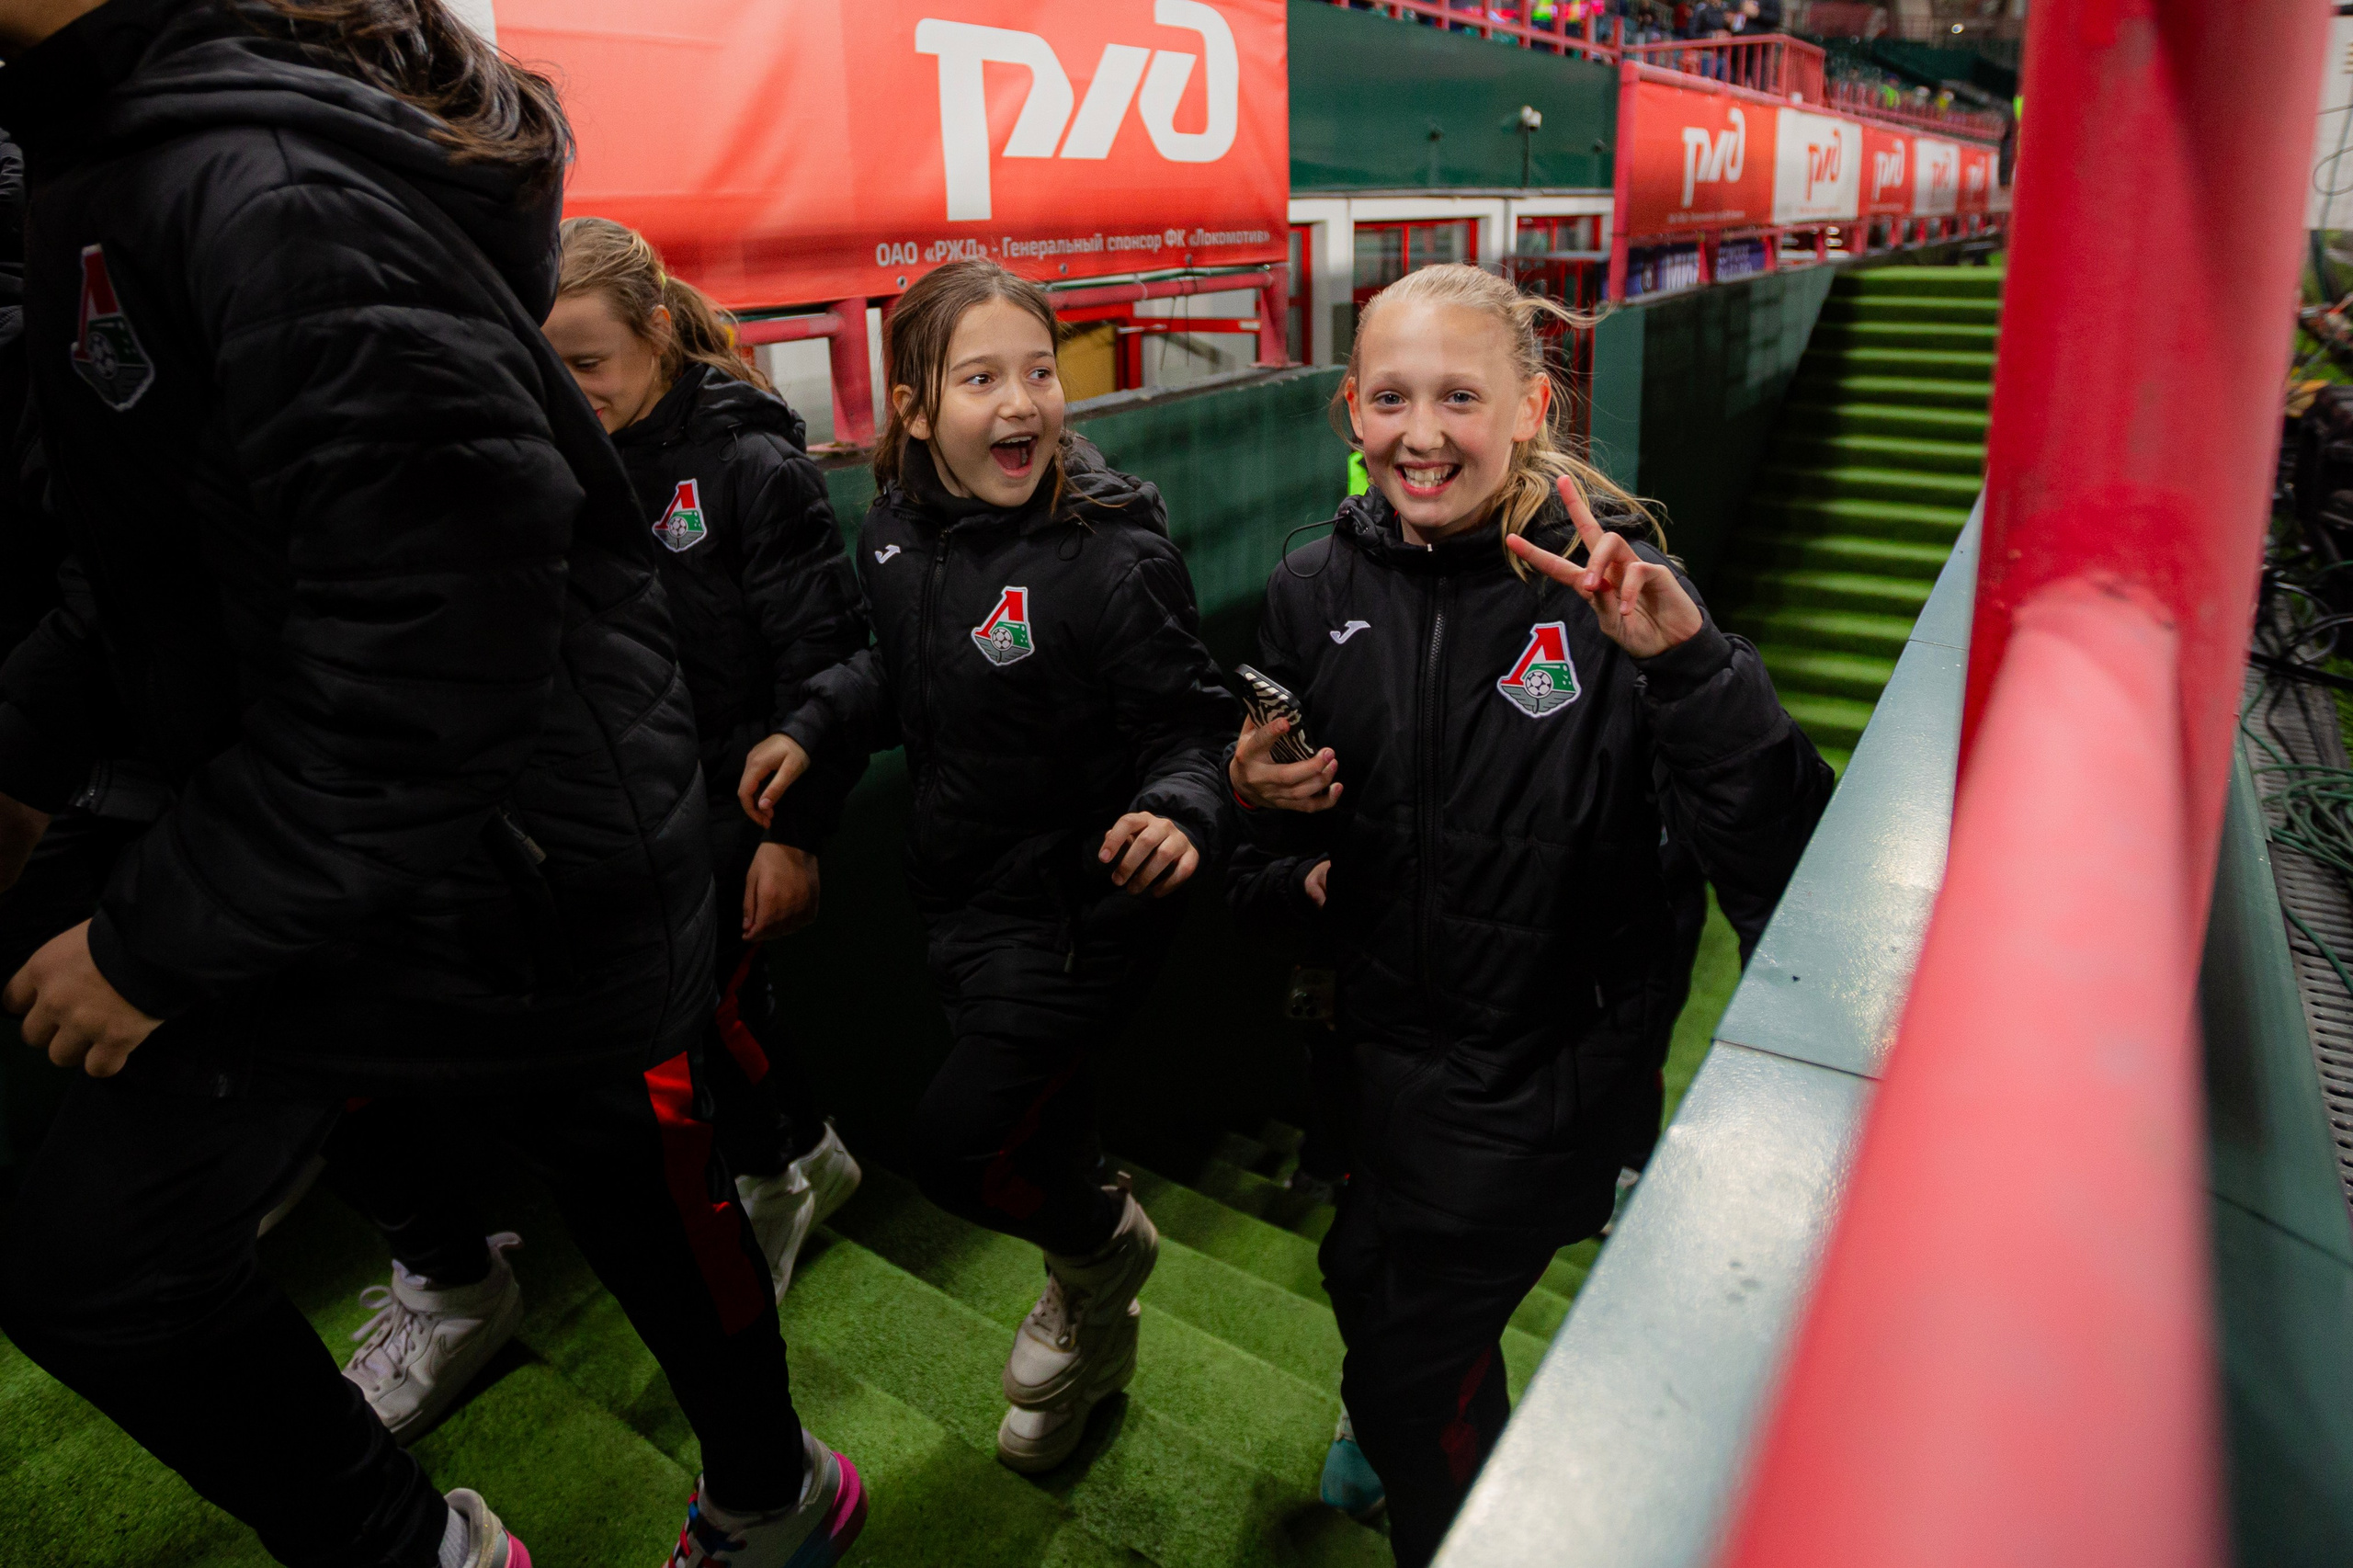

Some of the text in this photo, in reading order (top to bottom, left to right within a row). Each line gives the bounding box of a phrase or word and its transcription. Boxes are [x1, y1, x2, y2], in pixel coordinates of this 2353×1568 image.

[876, 241, 917, 267] ОАО
[925, 238, 988, 263] «РЖД»
[1002, 233, 1103, 261] Генеральный
[1107, 233, 1162, 253] спонсор
[1164, 228, 1186, 247] ФК
[1188, 228, 1270, 247] «Локомотив»
